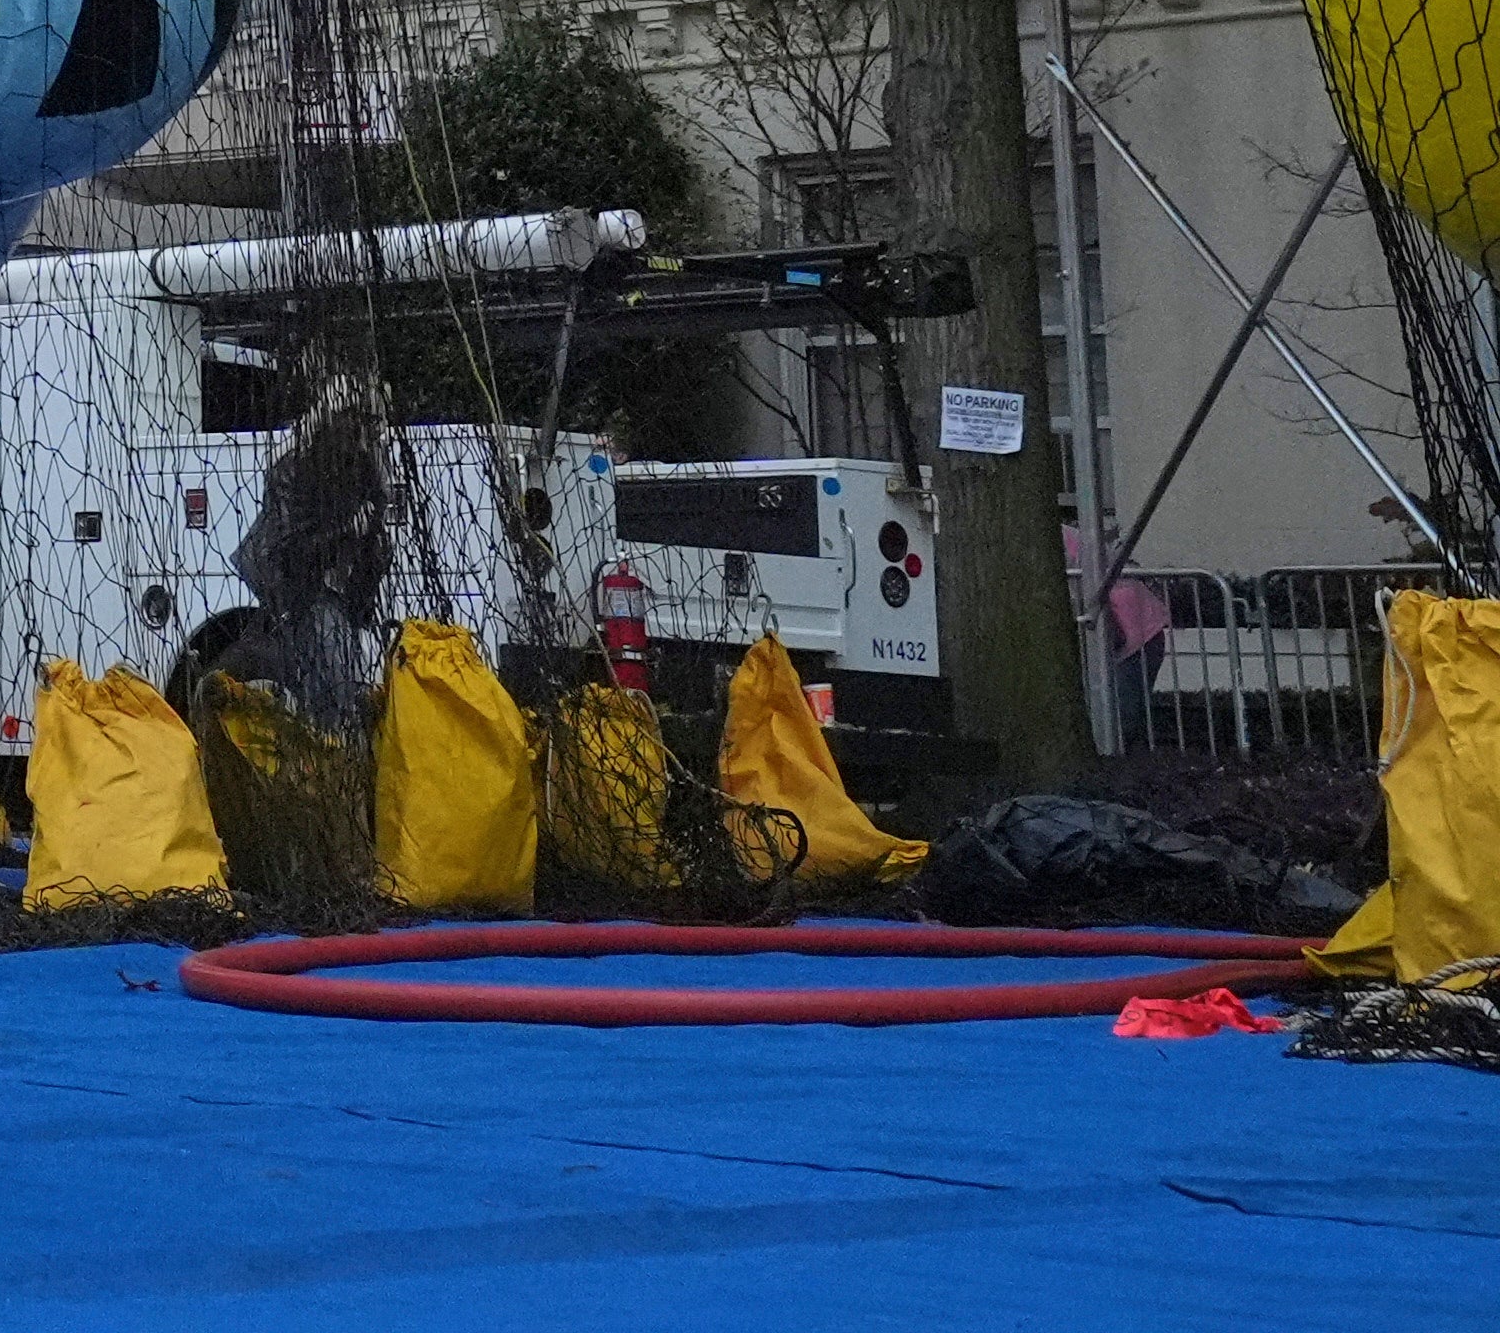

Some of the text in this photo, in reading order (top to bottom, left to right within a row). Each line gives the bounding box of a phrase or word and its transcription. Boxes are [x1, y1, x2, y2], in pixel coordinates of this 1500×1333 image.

[946, 394, 1019, 412] NO PARKING
[872, 638, 926, 662] N1432
